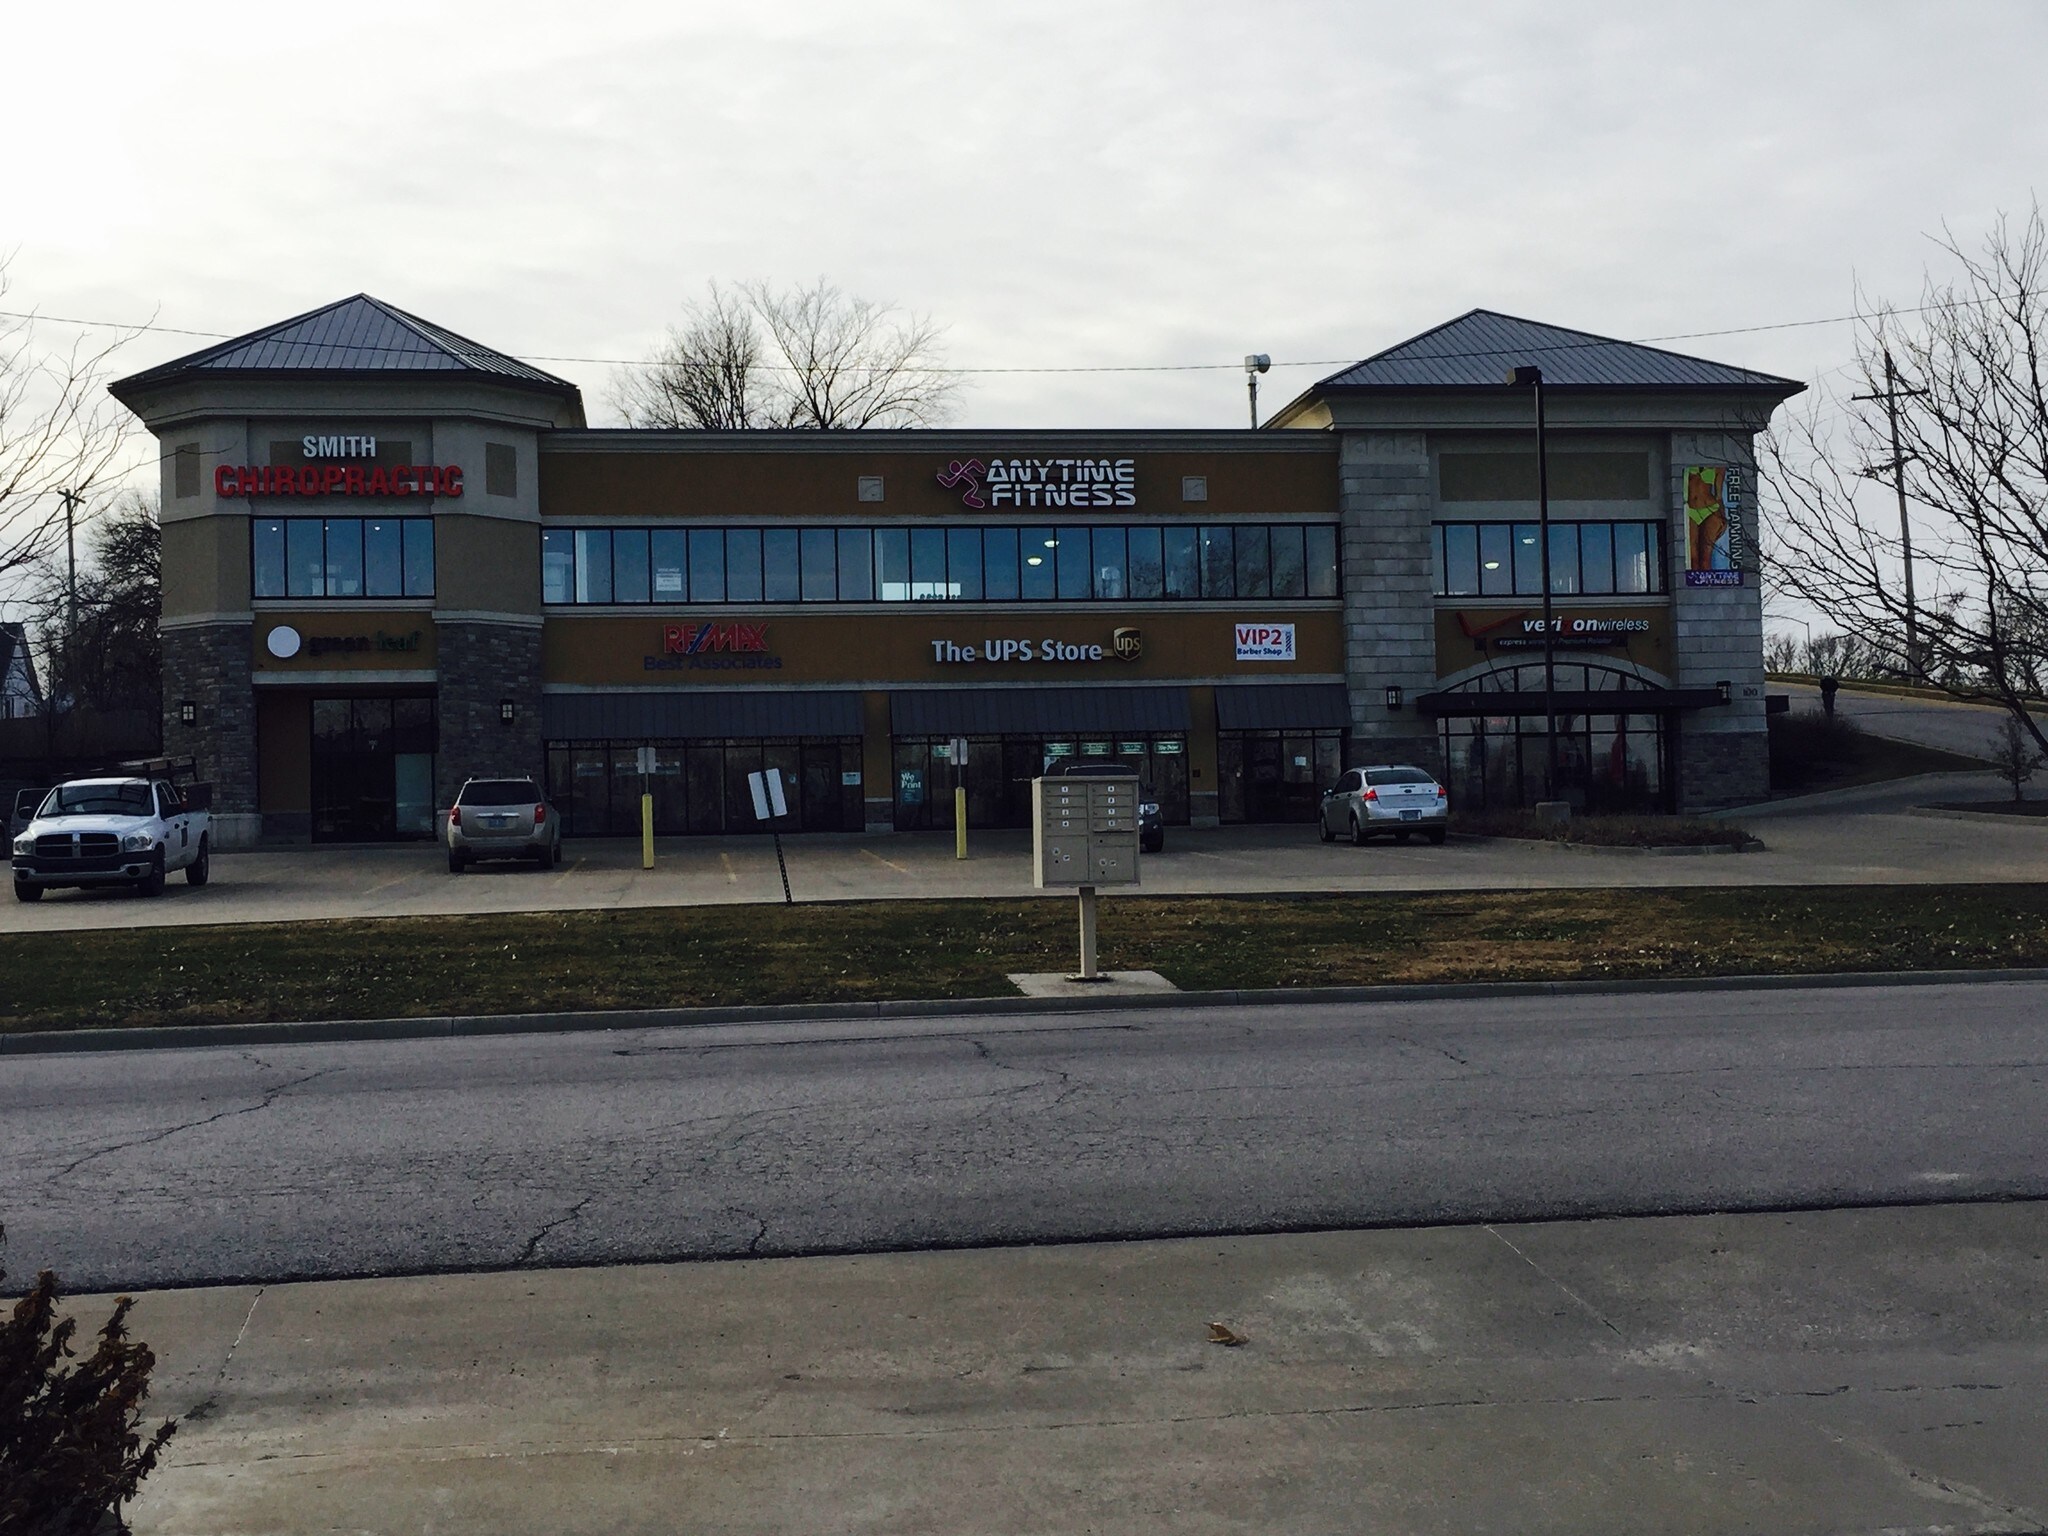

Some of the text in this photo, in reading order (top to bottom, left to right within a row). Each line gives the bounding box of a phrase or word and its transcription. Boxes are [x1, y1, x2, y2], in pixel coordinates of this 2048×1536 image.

[302, 435, 376, 458] SMITH
[214, 464, 463, 497] CHIROPRACTIC
[985, 458, 1134, 482] ANYTIME
[991, 483, 1136, 507] FITNESS
[1728, 466, 1744, 571] FREE TANNING
[664, 622, 770, 655] RE/MAX
[1115, 636, 1140, 657] ups
[1237, 629, 1282, 646] VIP2
[931, 638, 1102, 662] The UPS Store
[1237, 647, 1283, 657] Barber Shop
[643, 655, 783, 671] Best Associates
[901, 772, 915, 782] We
[901, 781, 921, 789] Print
